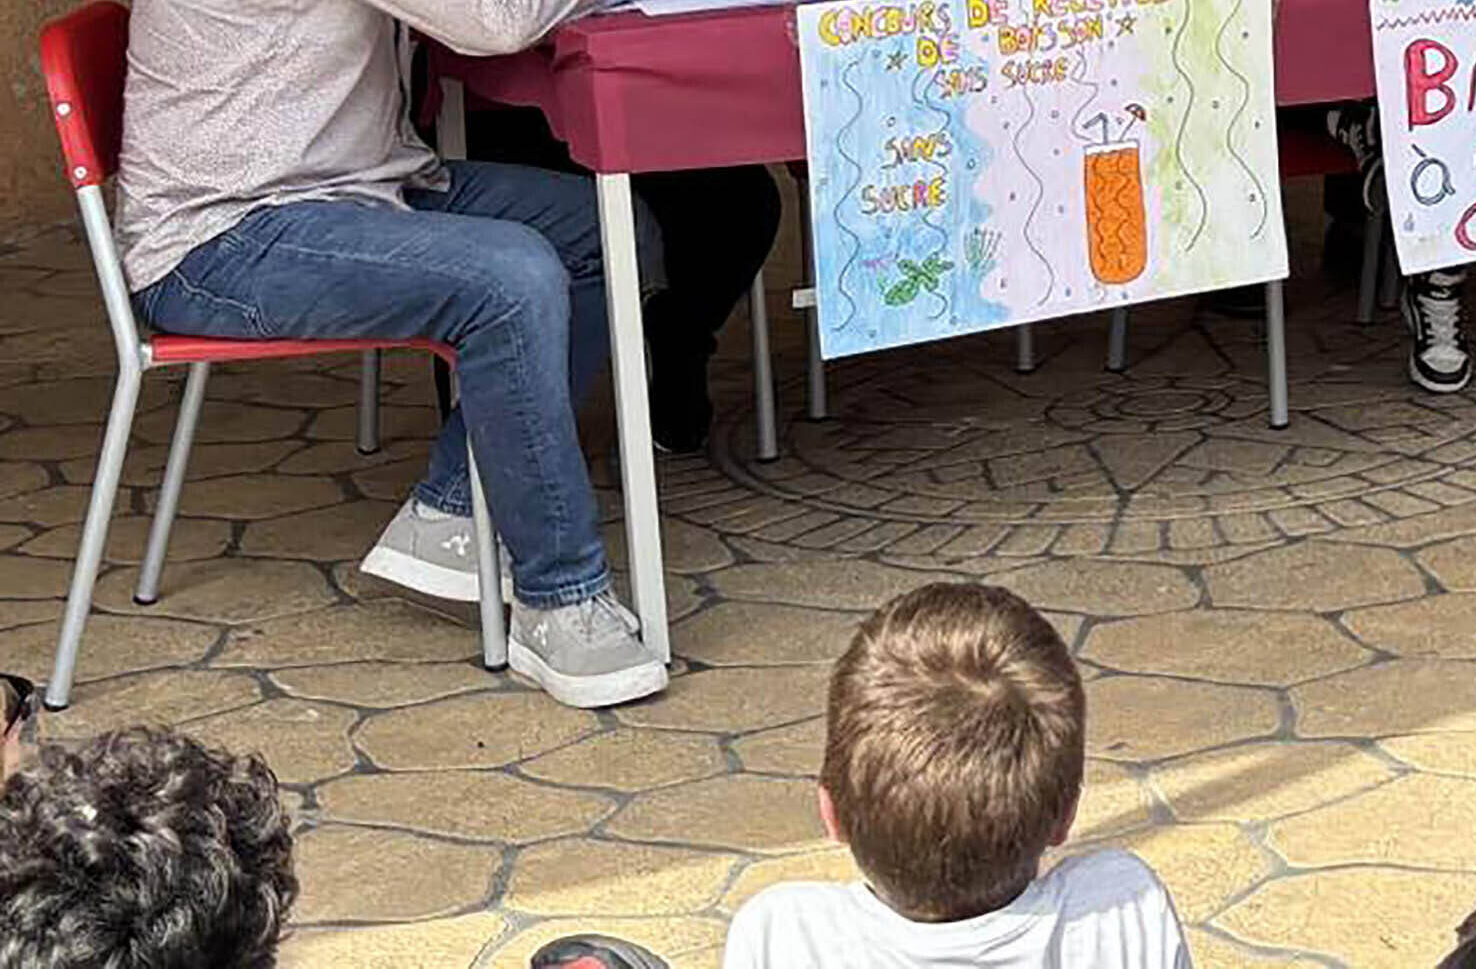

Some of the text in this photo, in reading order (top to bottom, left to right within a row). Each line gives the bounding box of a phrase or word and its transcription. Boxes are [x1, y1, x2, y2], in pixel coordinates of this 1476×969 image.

[818, 0, 950, 46] CONCOURS
[916, 31, 960, 68] DE
[861, 175, 947, 215] SUCRE
[1410, 143, 1456, 207] à
